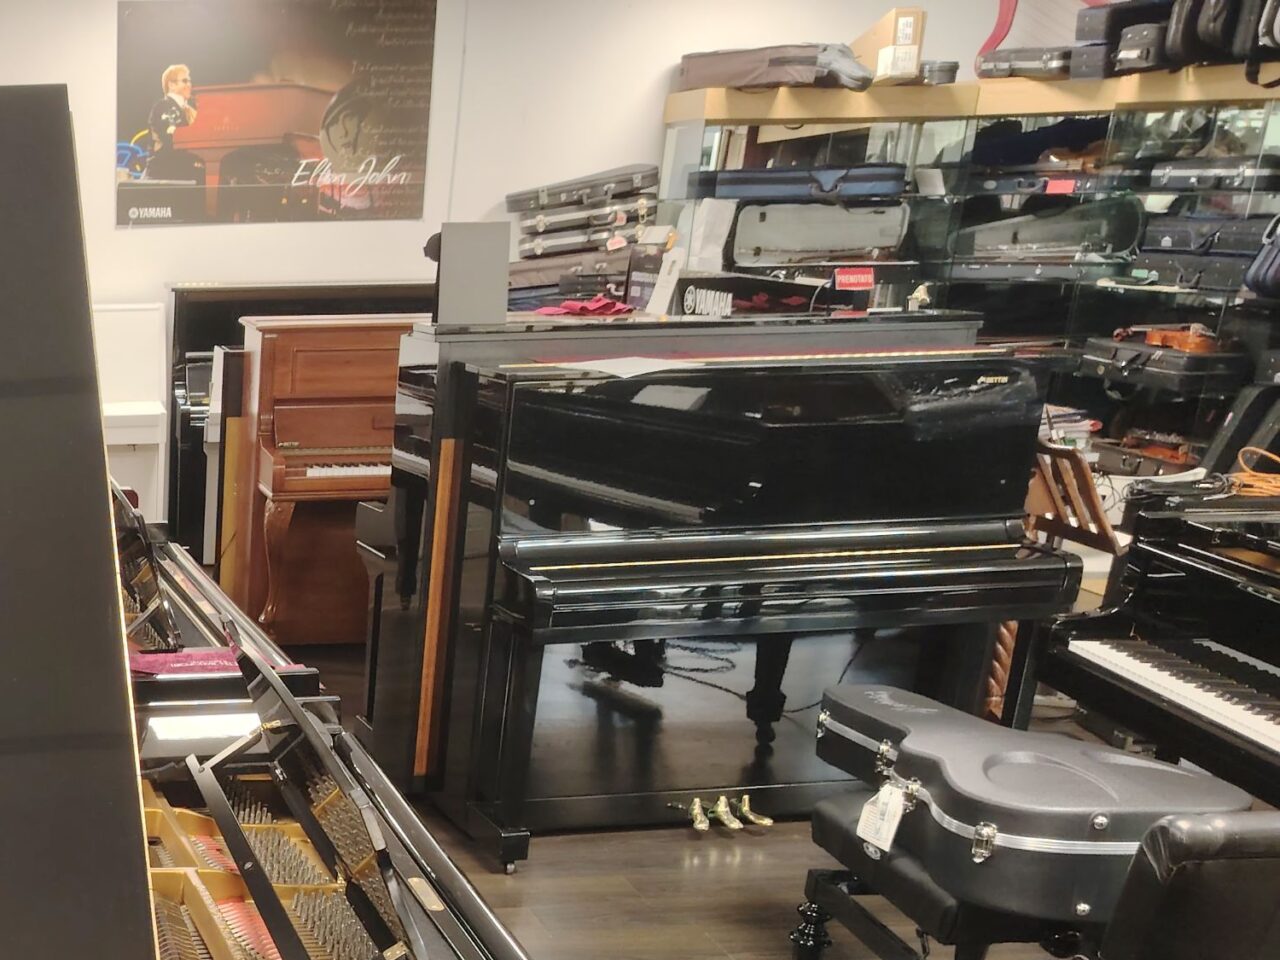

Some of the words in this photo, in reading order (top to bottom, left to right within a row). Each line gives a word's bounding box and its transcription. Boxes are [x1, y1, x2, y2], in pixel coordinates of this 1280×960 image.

[291, 157, 346, 187] Elton
[346, 154, 412, 197] John
[138, 207, 172, 218] YAMAHA
[694, 288, 733, 317] YAMAHA
